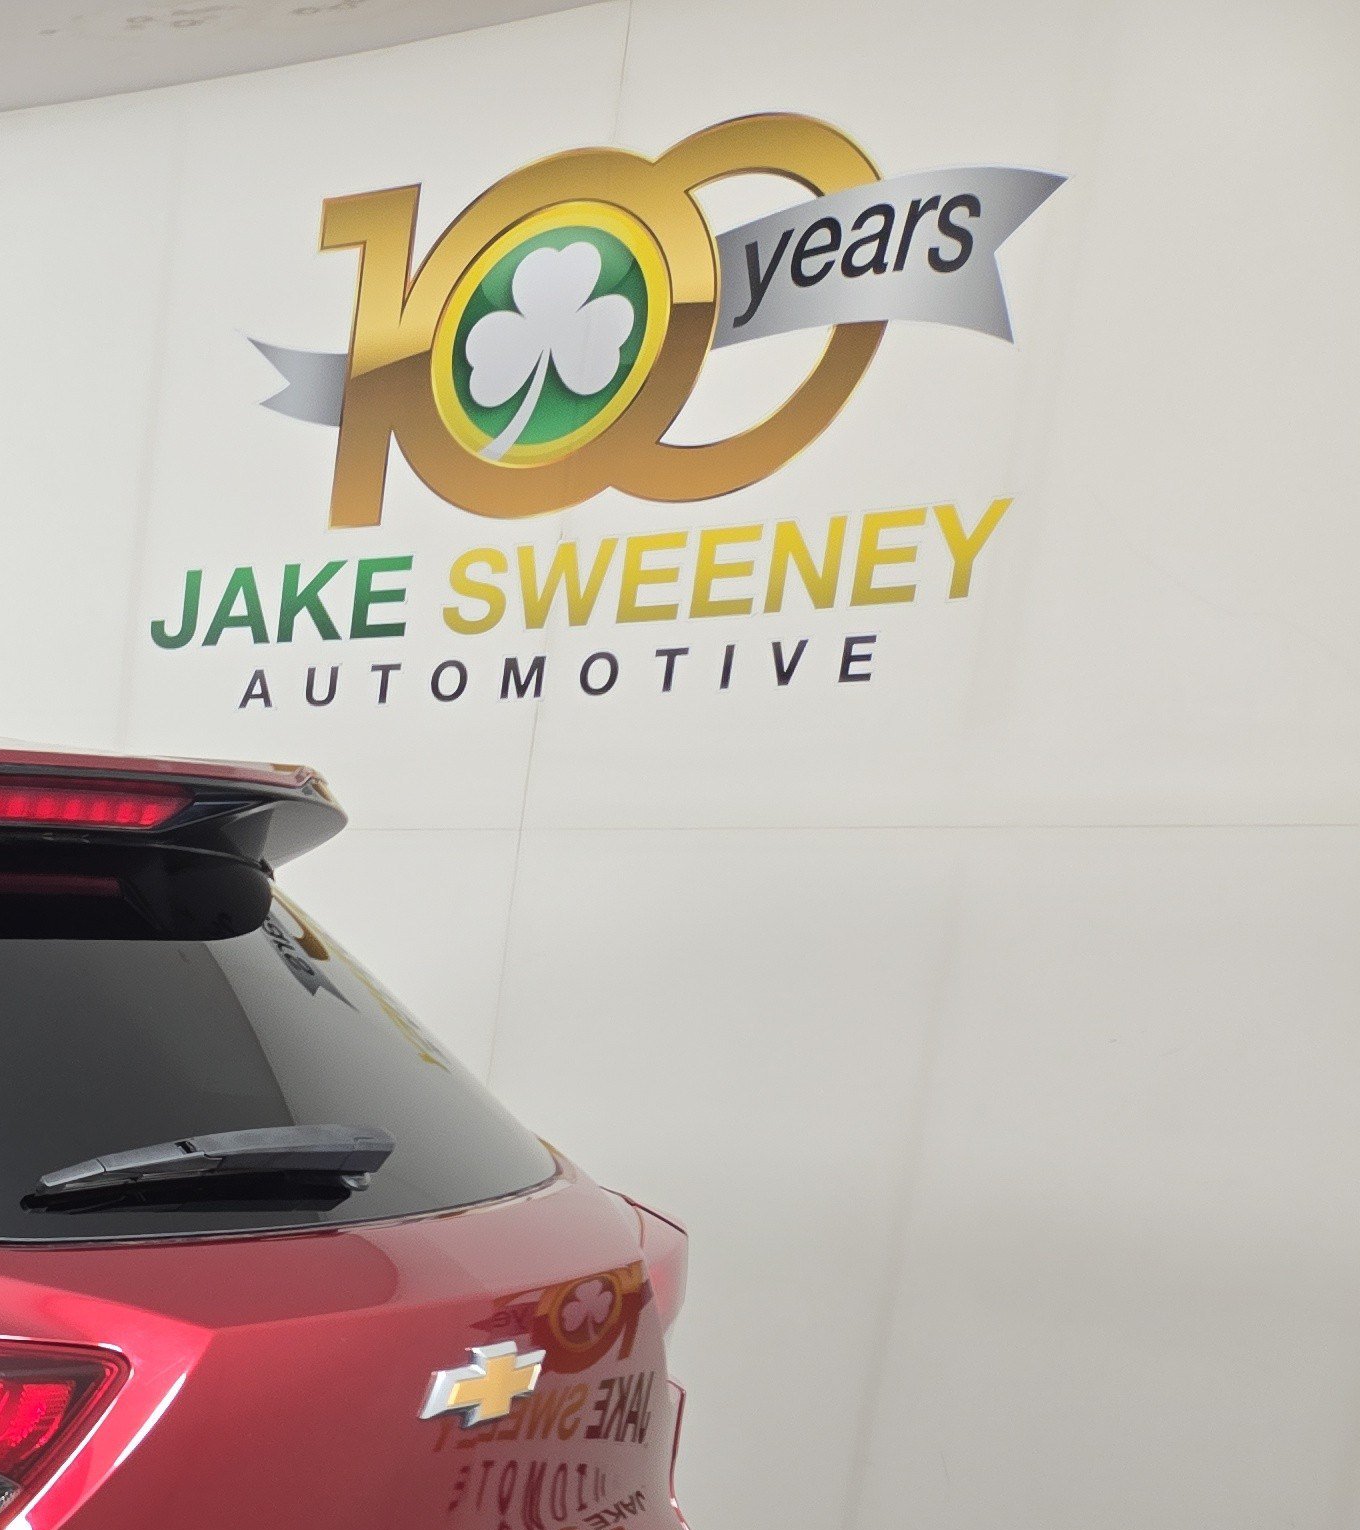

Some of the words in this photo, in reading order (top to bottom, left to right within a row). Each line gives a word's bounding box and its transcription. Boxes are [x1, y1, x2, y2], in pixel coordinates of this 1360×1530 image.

[733, 193, 981, 328] years
[150, 555, 413, 650] JAKE
[443, 497, 1013, 636] SWEENEY
[238, 635, 877, 710] AUTOMOTIVE
